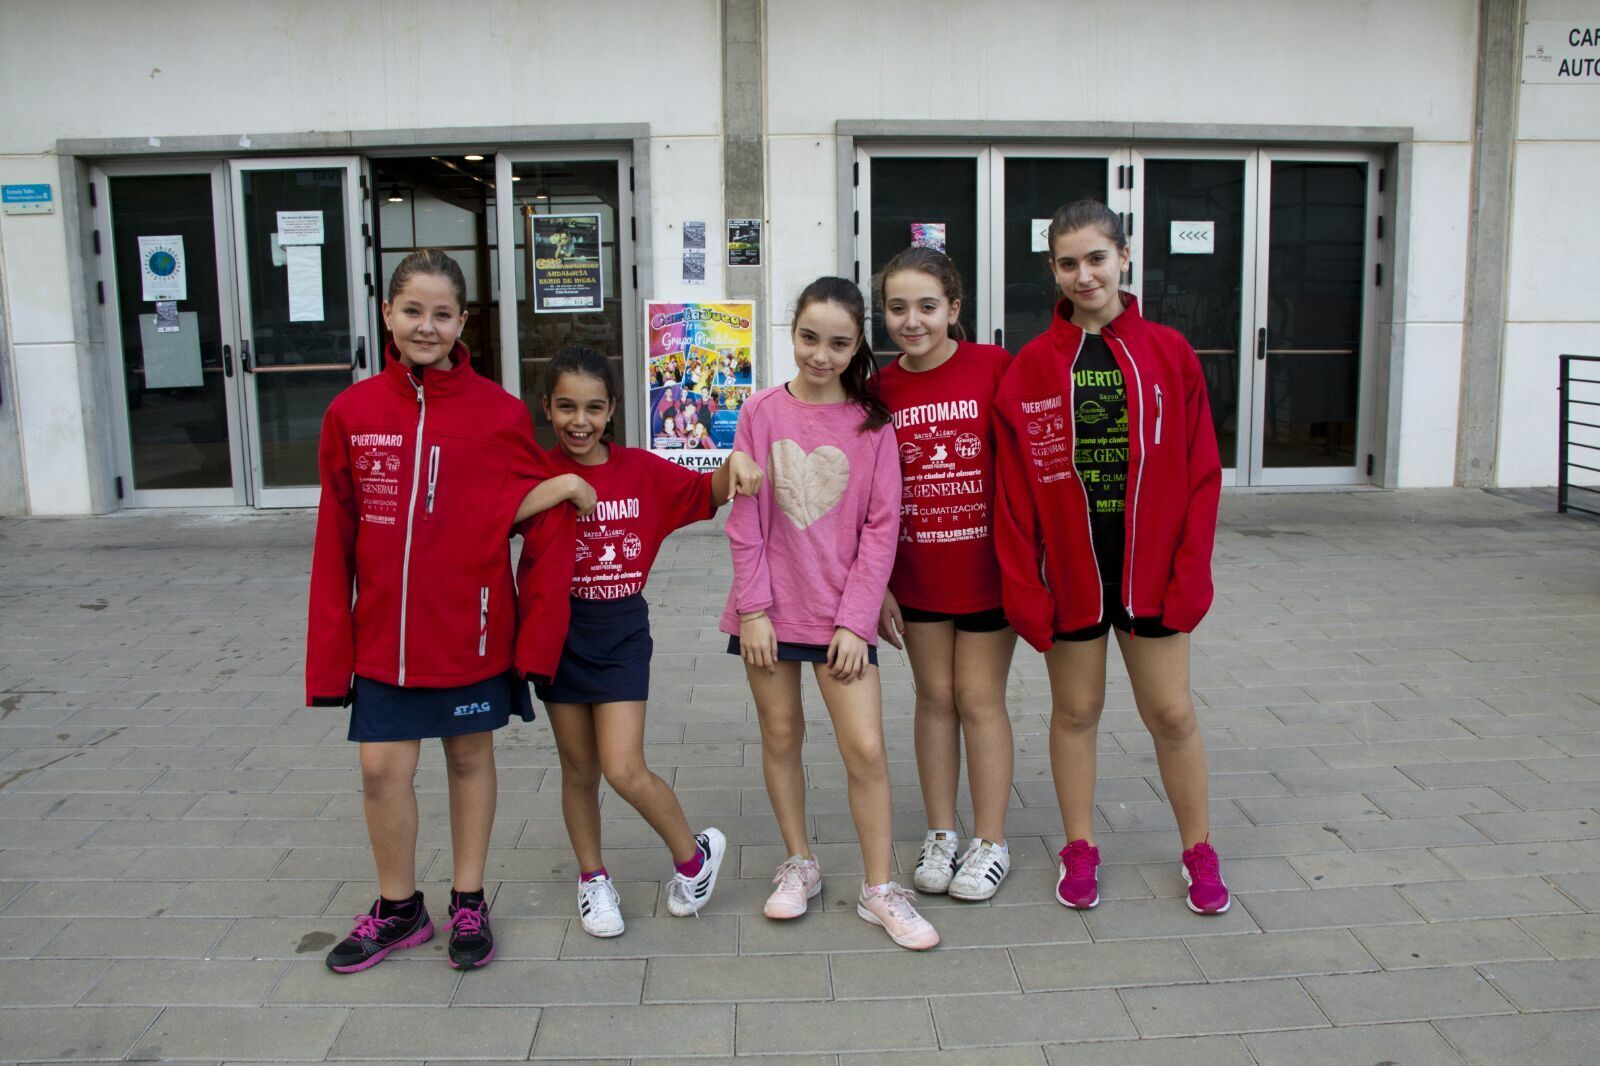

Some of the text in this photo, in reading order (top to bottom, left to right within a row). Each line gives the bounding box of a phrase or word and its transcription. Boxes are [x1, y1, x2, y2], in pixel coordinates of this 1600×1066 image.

[351, 433, 403, 447] PUERTOMARO
[914, 479, 983, 498] GENERALI
[919, 502, 986, 516] CLIMATIZACIÓN
[916, 525, 988, 539] MITSUBISHI
